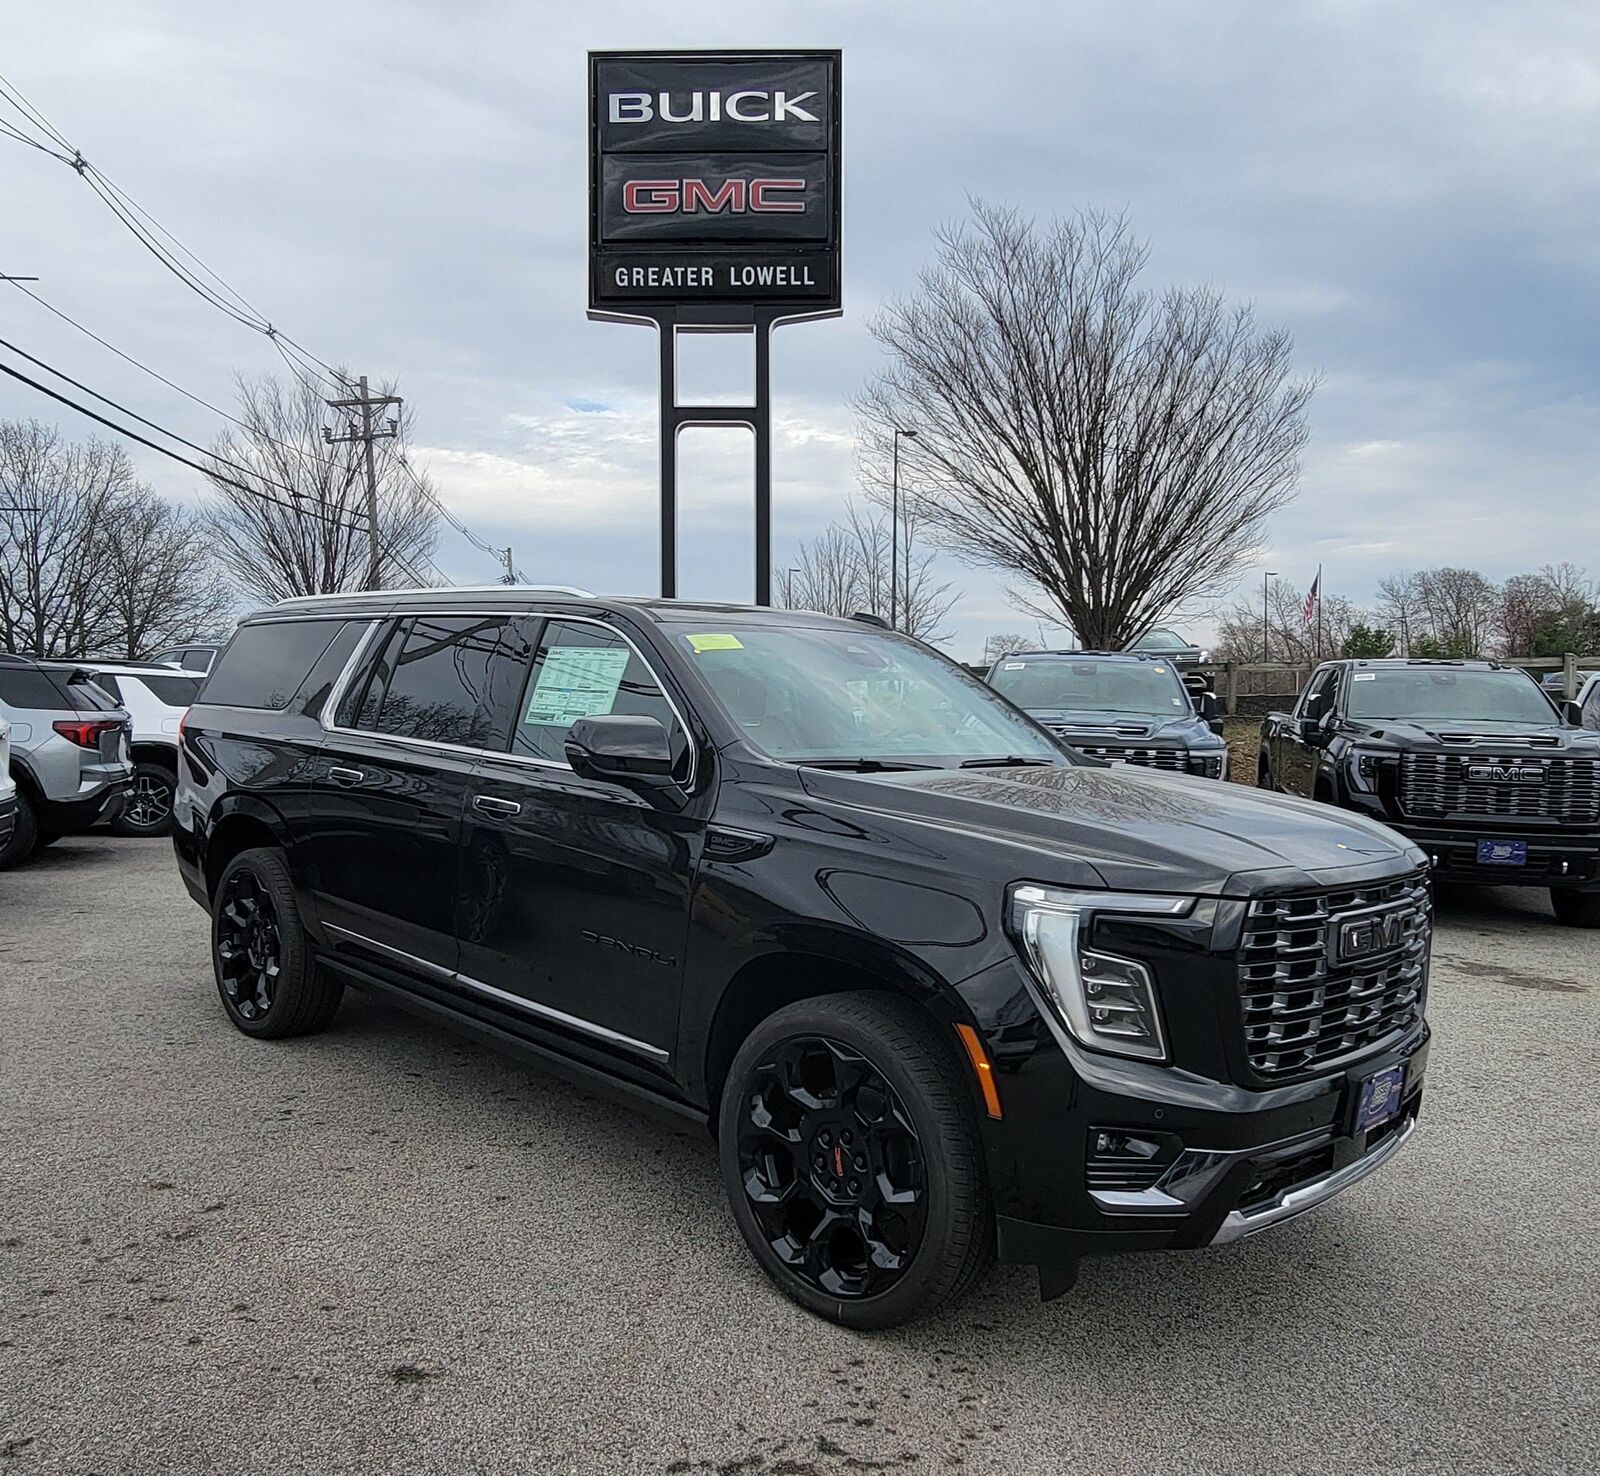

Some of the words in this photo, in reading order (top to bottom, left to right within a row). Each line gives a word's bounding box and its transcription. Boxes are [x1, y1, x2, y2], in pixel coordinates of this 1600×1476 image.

[608, 91, 821, 123] BUICK
[623, 178, 806, 214] GMC
[615, 266, 714, 287] GREATER
[730, 266, 815, 286] LOWELL
[1469, 766, 1544, 782] GMC
[1340, 907, 1417, 958] GMC
